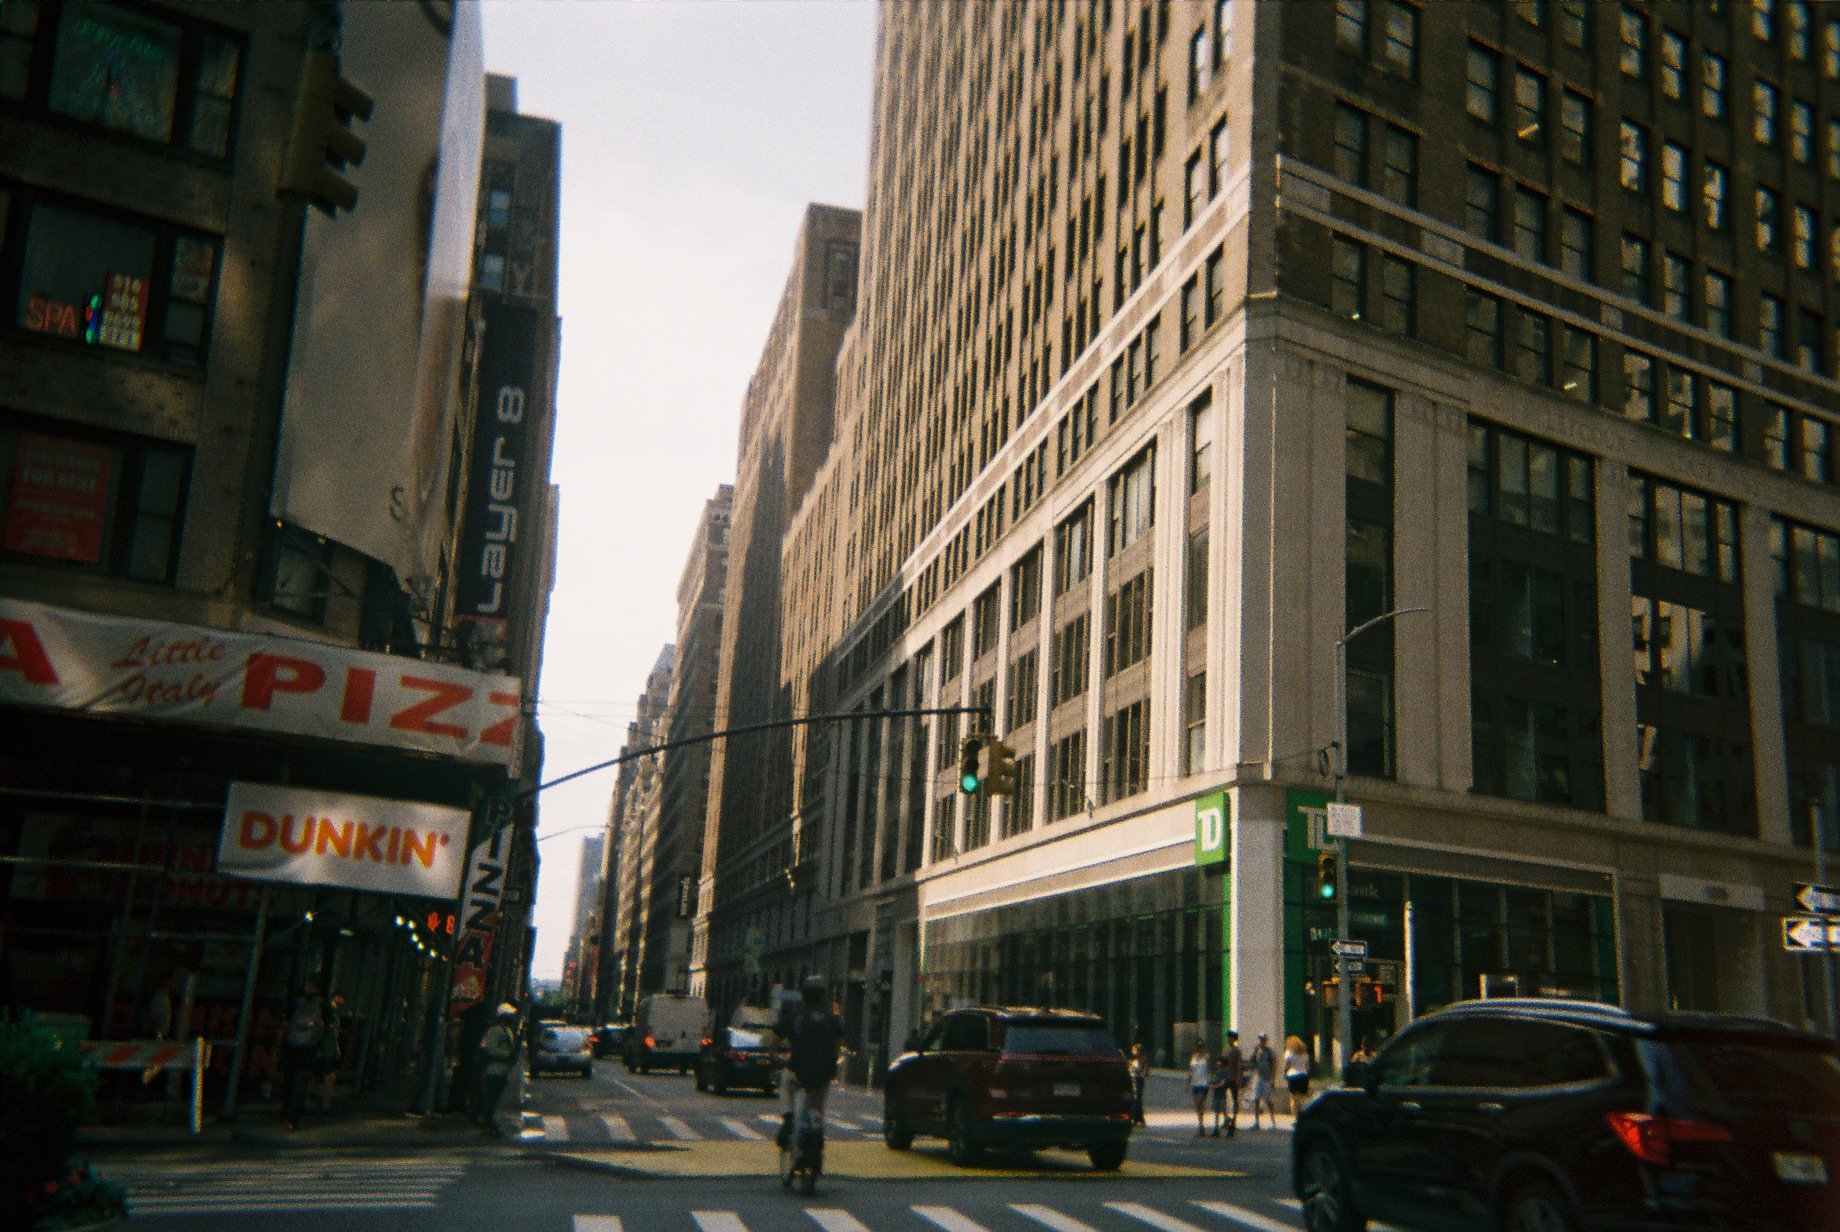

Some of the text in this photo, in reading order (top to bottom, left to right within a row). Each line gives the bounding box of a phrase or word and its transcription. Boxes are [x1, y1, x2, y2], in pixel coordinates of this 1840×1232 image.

[26, 296, 78, 338] SPA
[477, 437, 519, 613] Layer
[498, 386, 525, 424] 8
[109, 635, 225, 670] Little
[121, 673, 219, 707] Italy
[238, 811, 449, 868] DUNKIN'
[1198, 808, 1222, 851] TD
[456, 797, 515, 968] PIZZA
